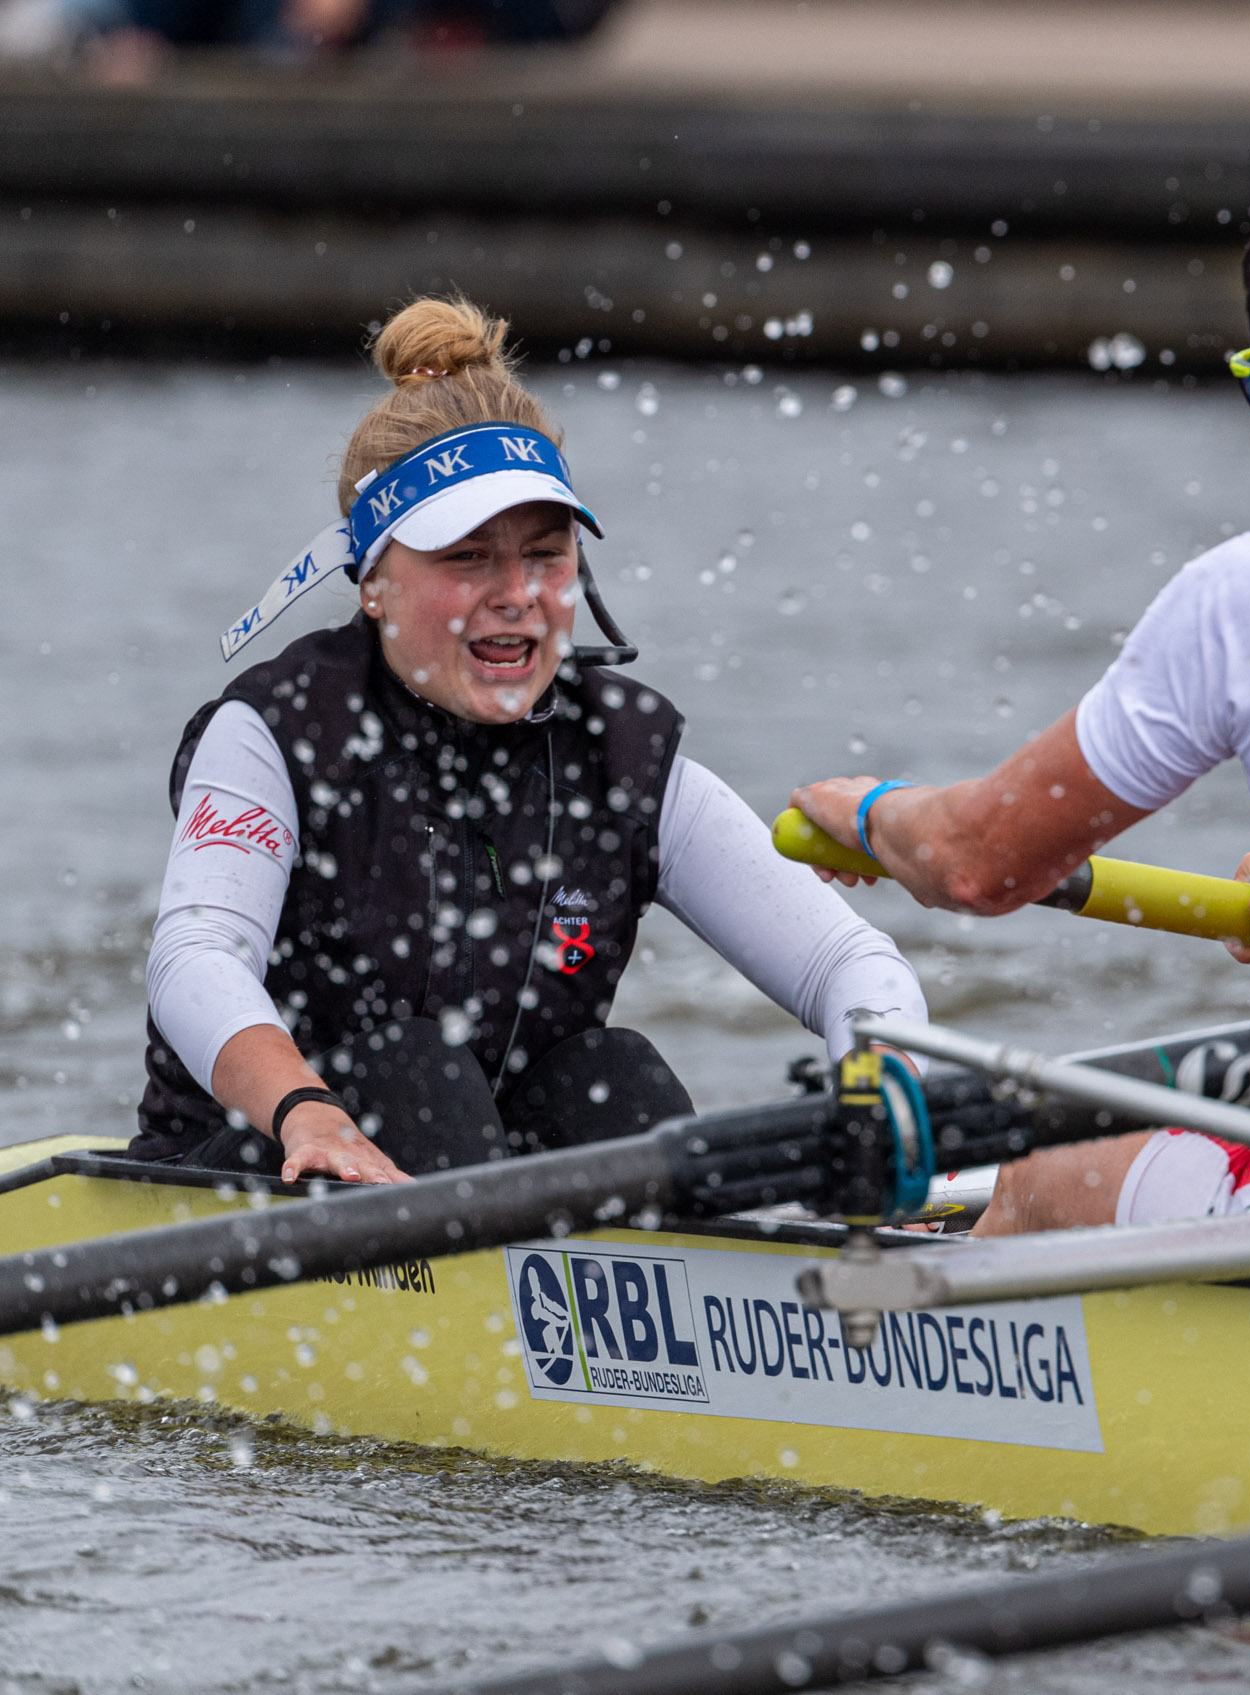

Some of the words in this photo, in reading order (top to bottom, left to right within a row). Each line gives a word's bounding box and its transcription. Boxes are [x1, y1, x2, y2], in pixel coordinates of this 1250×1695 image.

[423, 444, 474, 486] NK
[498, 437, 546, 465] NK
[367, 478, 405, 528] NK
[553, 916, 589, 926] ACHTER
[570, 1256, 699, 1367] RBL
[590, 1365, 706, 1398] RUDER-BUNDESLIGA
